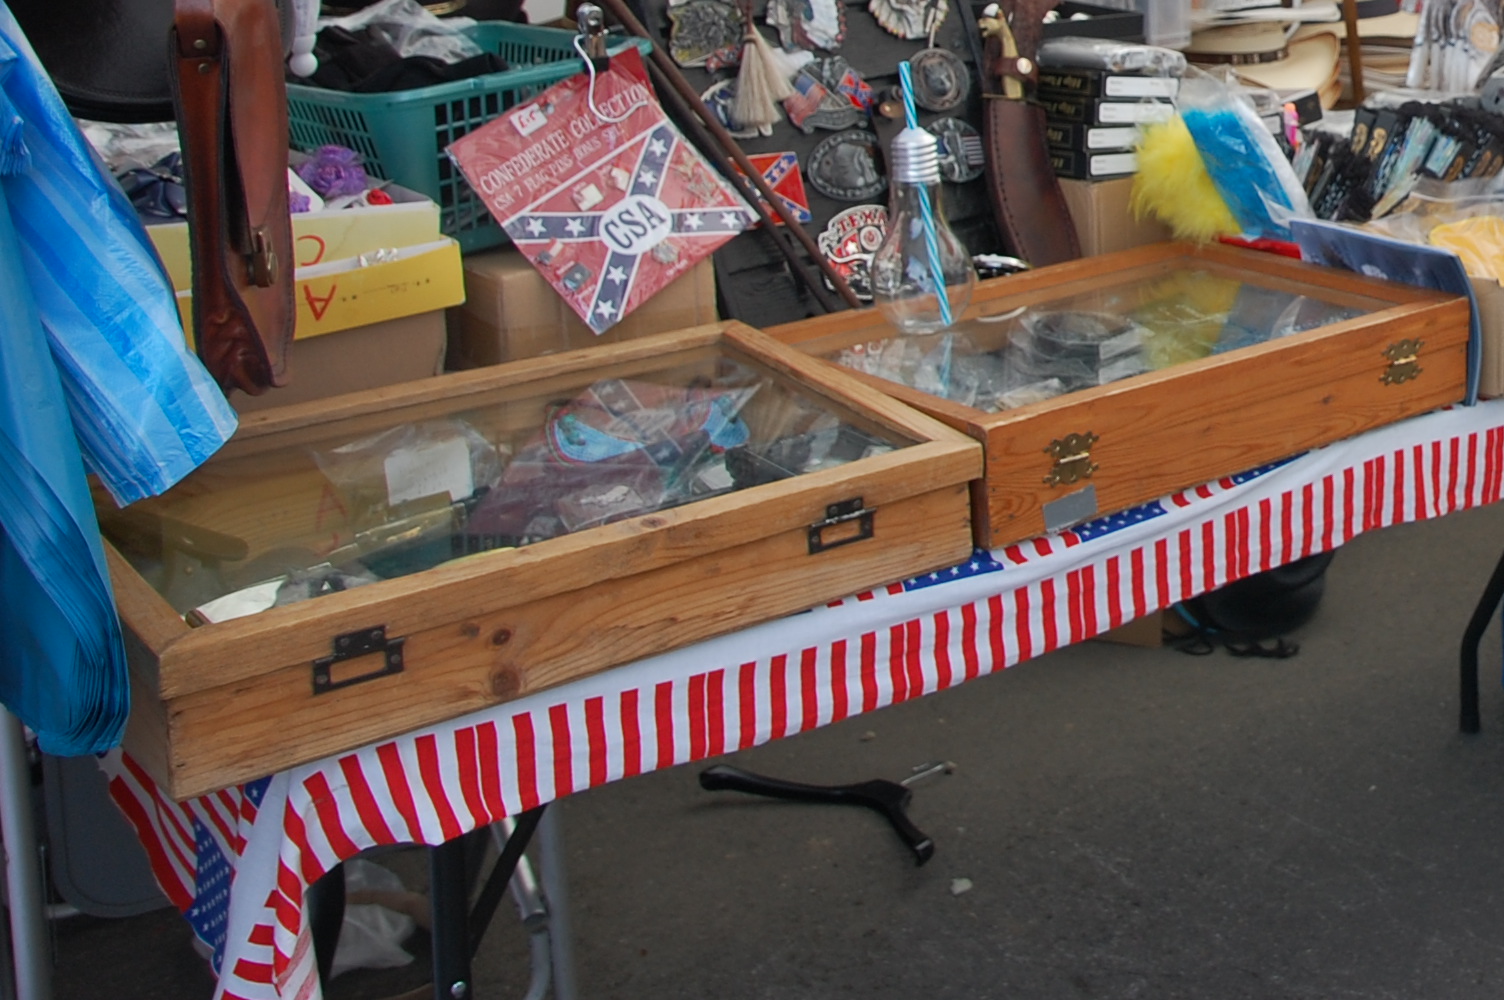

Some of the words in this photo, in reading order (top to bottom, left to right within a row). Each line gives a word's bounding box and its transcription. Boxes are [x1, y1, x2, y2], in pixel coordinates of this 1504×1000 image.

[480, 129, 570, 195] CONFEDERATE
[523, 168, 549, 192] FLAG
[602, 202, 667, 250] CSA
[836, 208, 890, 235] TEXA
